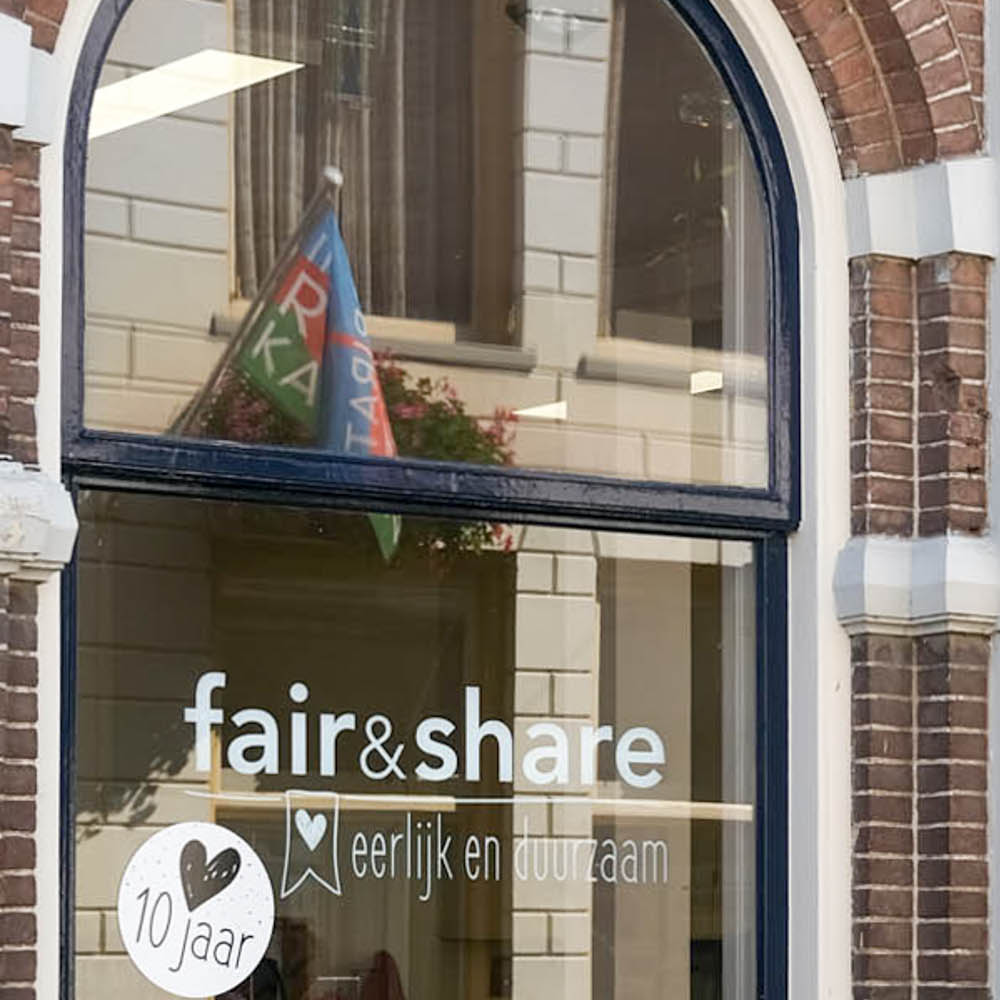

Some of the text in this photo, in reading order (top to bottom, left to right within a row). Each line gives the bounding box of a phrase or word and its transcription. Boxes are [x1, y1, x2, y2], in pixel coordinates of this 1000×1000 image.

[184, 672, 666, 788] fair&share
[352, 812, 669, 901] eerlijk en duurzaam
[136, 888, 253, 973] 10 jaar
